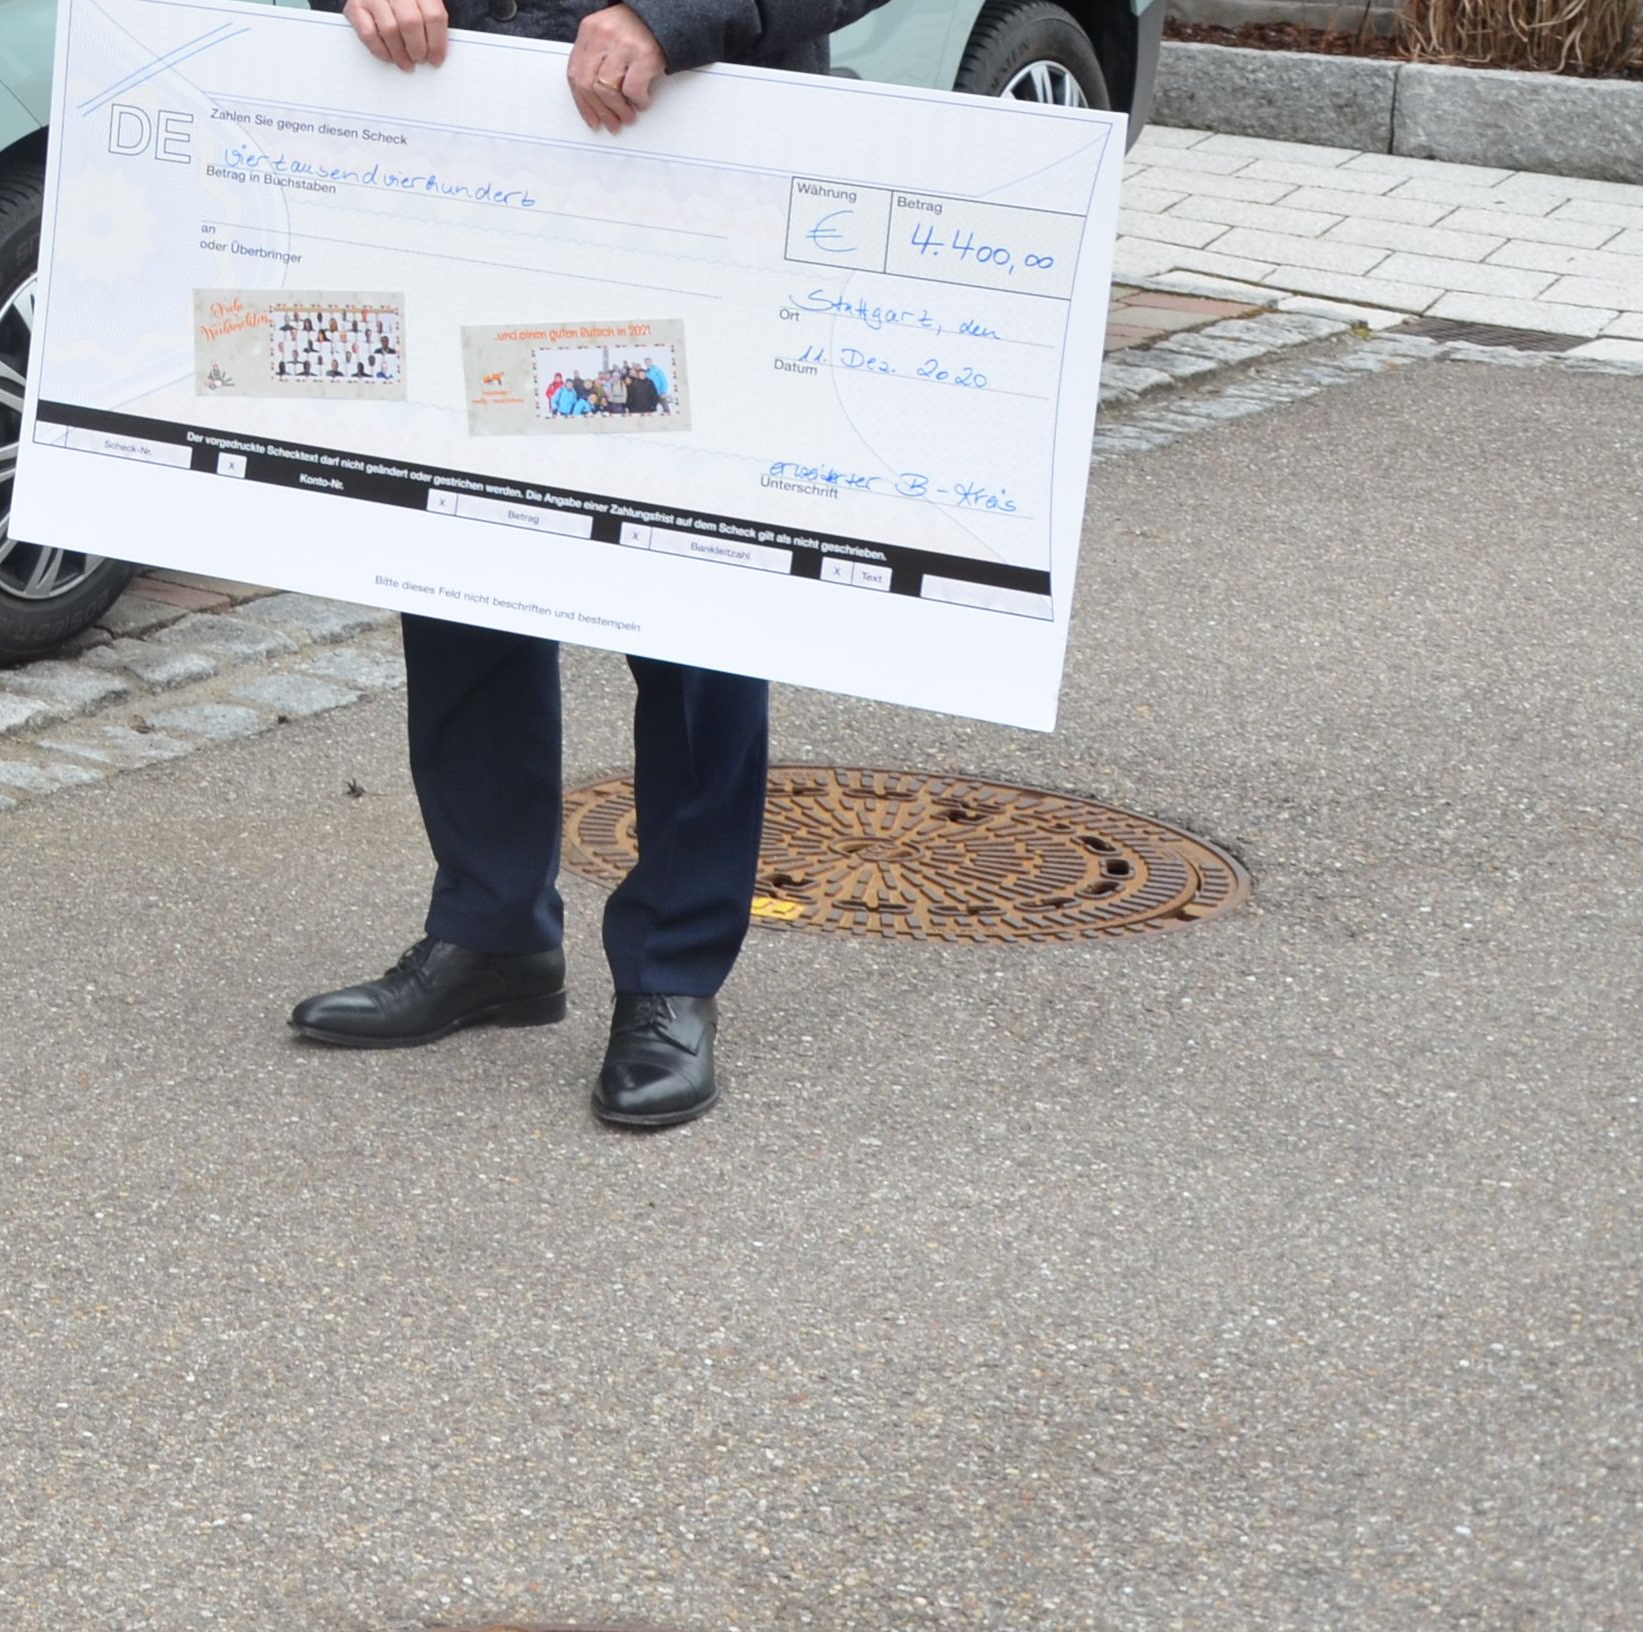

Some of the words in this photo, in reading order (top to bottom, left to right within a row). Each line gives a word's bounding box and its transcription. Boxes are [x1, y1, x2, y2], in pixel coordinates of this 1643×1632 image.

[108, 103, 195, 165] DE
[210, 107, 251, 125] Zahlen
[254, 113, 274, 127] Sie
[277, 118, 315, 135] gegen
[318, 122, 359, 139] diesen
[361, 128, 409, 146] Scheck
[206, 164, 247, 184] Betrag
[249, 170, 260, 183] in
[264, 171, 337, 196] Buchstaben
[797, 181, 858, 203] Währung
[897, 195, 944, 216] Betrag
[201, 224, 216, 235] an
[805, 209, 858, 254] €
[199, 239, 228, 252] oder
[230, 239, 303, 264] Überbringer
[910, 221, 1055, 275] 4.400,00
[778, 307, 800, 322] Ort
[549, 326, 578, 342] guten
[617, 324, 626, 337] in
[628, 323, 652, 337] 2021
[774, 357, 818, 377] Datum
[916, 358, 988, 389] 2020
[105, 439, 153, 457] Scheck-Nr.
[299, 472, 344, 491] Konto-Nr.
[759, 474, 840, 500] Unterschrift
[187, 430, 204, 444] Der
[205, 434, 266, 455] vorgedruckte
[266, 444, 319, 464] Schecktext
[320, 454, 341, 467] darf
[341, 457, 365, 471] nicht
[365, 462, 409, 480] geändert
[410, 469, 432, 483] oder
[433, 473, 484, 492] gestrichen
[485, 483, 524, 499] werden.
[525, 489, 543, 502] Die
[543, 492, 583, 510] Angabe
[583, 499, 609, 513] einer
[609, 502, 675, 525] Zahlungsfrist
[675, 515, 693, 527] auf
[694, 518, 717, 532] dem
[718, 521, 757, 539] Scheck
[758, 528, 775, 543] gilt
[776, 532, 792, 546] als
[793, 535, 820, 550] nicht
[820, 540, 888, 561] geschrieben.
[507, 509, 540, 525] Betrag
[690, 541, 751, 561] Bankleitzahl
[861, 571, 882, 584] Text
[375, 575, 399, 589] Bitte
[402, 580, 436, 596] dieses
[438, 586, 462, 600] Feld
[464, 591, 490, 606] nicht
[492, 596, 552, 617] beschriften
[554, 608, 575, 621] und
[577, 611, 641, 633] bestempeln
